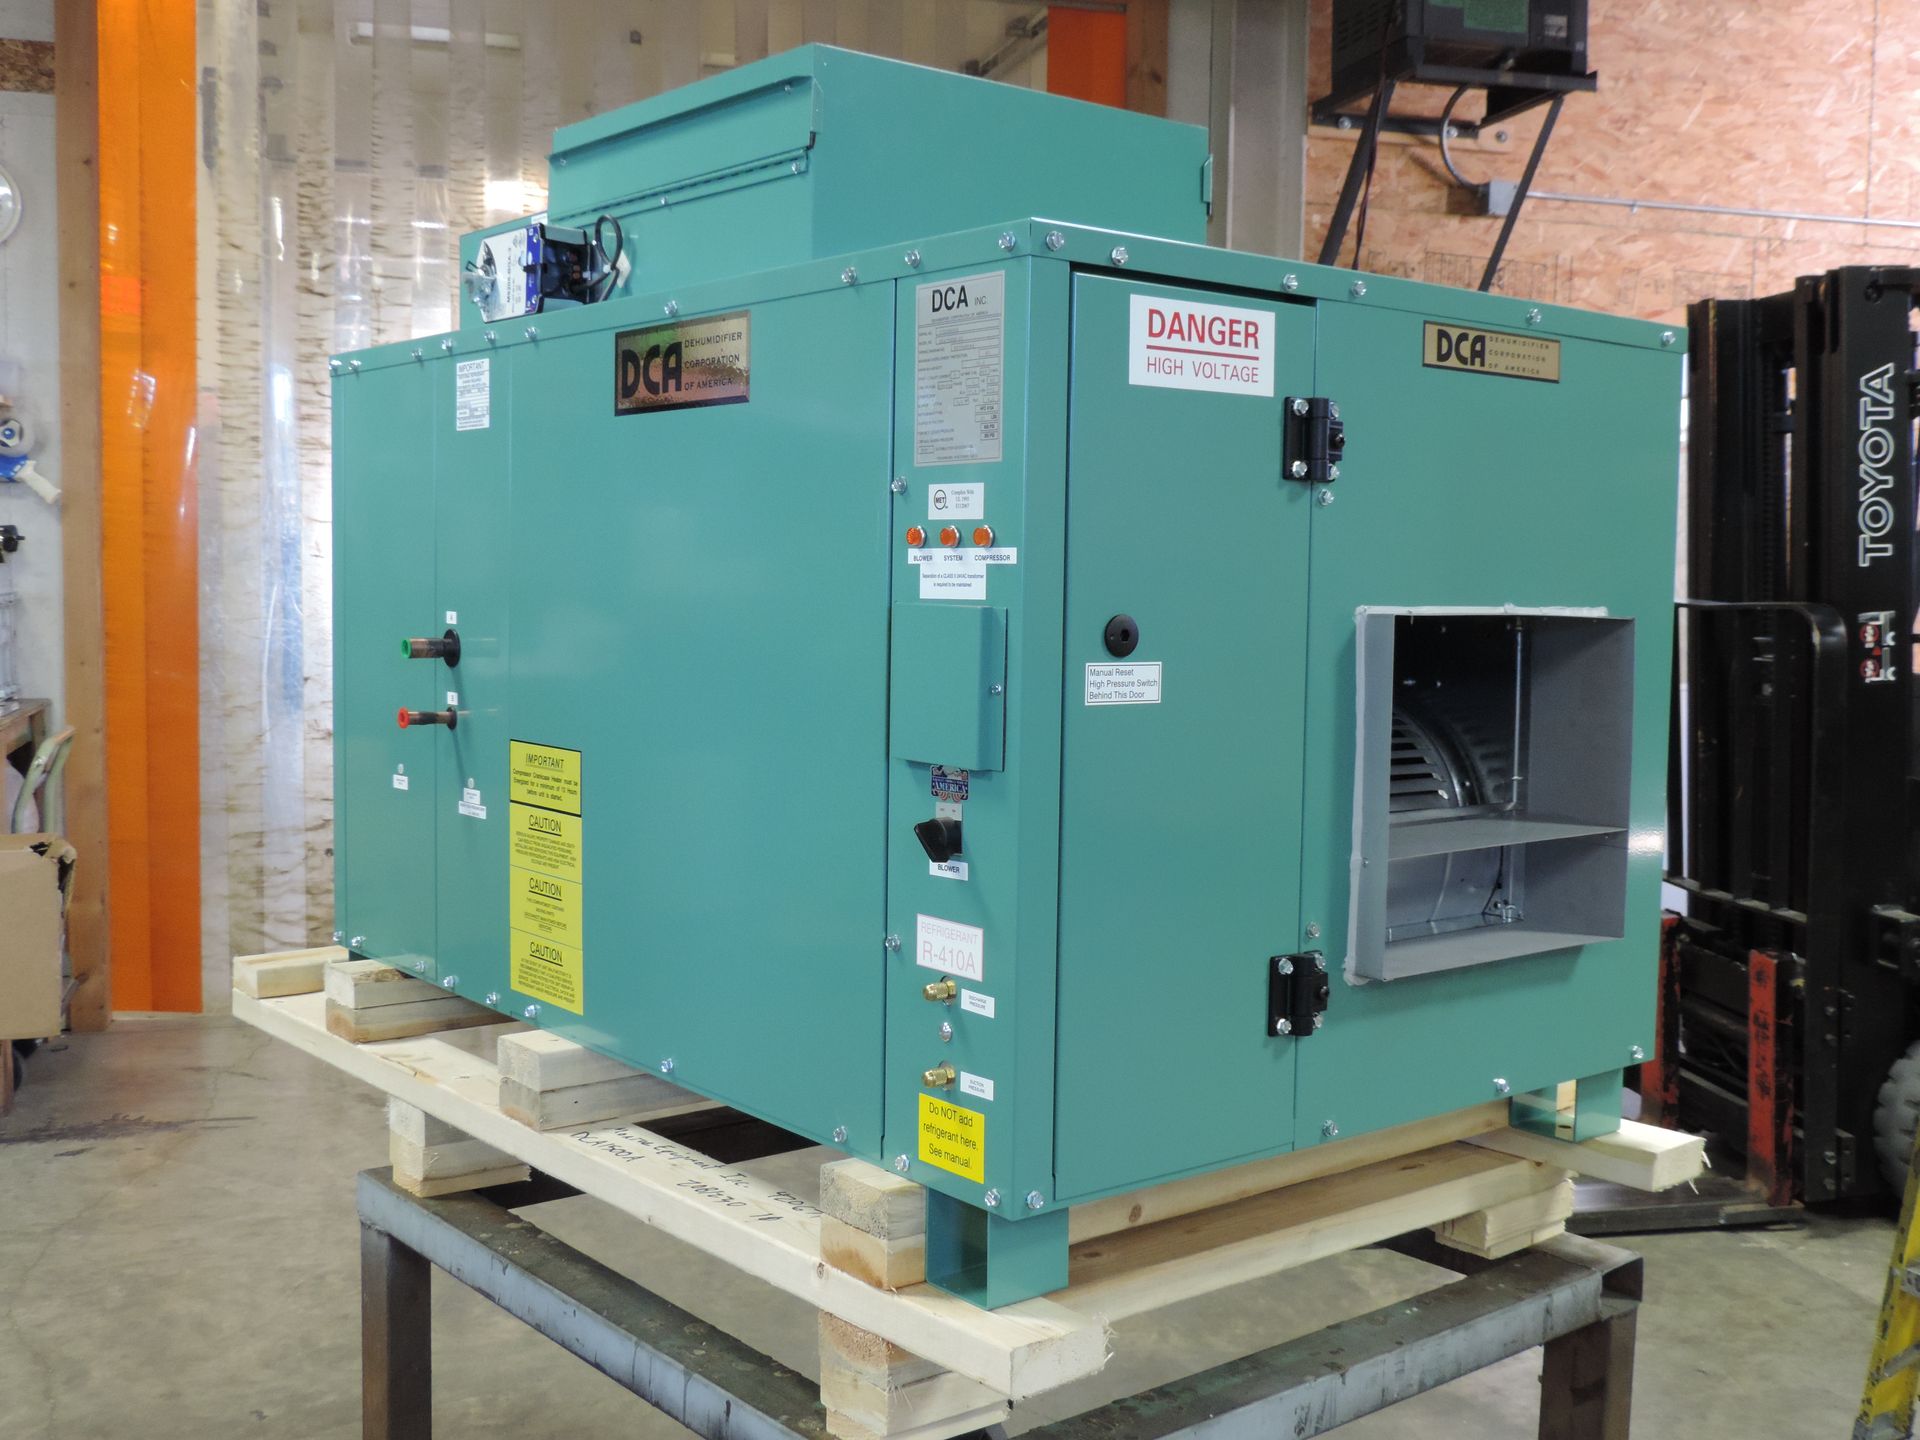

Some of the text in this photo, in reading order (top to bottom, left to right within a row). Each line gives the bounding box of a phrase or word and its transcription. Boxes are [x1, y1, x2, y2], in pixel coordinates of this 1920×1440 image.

[932, 285, 968, 312] DCA
[1148, 308, 1259, 349] DANGER
[1437, 328, 1550, 367] DCA DEHUMIDIFIER
[1488, 348, 1547, 363] CORPORATION
[622, 331, 743, 399] DCA DEHUMIDIFIER
[684, 353, 740, 369] CORPORATION
[1146, 356, 1260, 384] HIGH VOLTAGE
[1505, 364, 1541, 375] AMERICA
[684, 377, 734, 391] OF AMERICA
[1858, 362, 1895, 567] TOYOTA
[974, 554, 1011, 562] COMPRESSOR
[1089, 668, 1134, 677] Manual Reset
[1089, 679, 1158, 690] High Pressure Switch
[1089, 690, 1145, 700] Behind This Door
[525, 753, 564, 769] IMPORTANT
[933, 779, 967, 795] AMERICA
[529, 814, 562, 833] CAUTION
[937, 863, 961, 874] BLOWER
[529, 877, 562, 897] CAUTION
[921, 920, 978, 945] REFRIGERANT
[530, 941, 563, 963] CAUTION
[922, 941, 976, 974] R-410A
[929, 1102, 973, 1128] Do NOT add
[923, 1121, 979, 1151] refrigerant here.
[929, 1143, 973, 1168] See manual.
